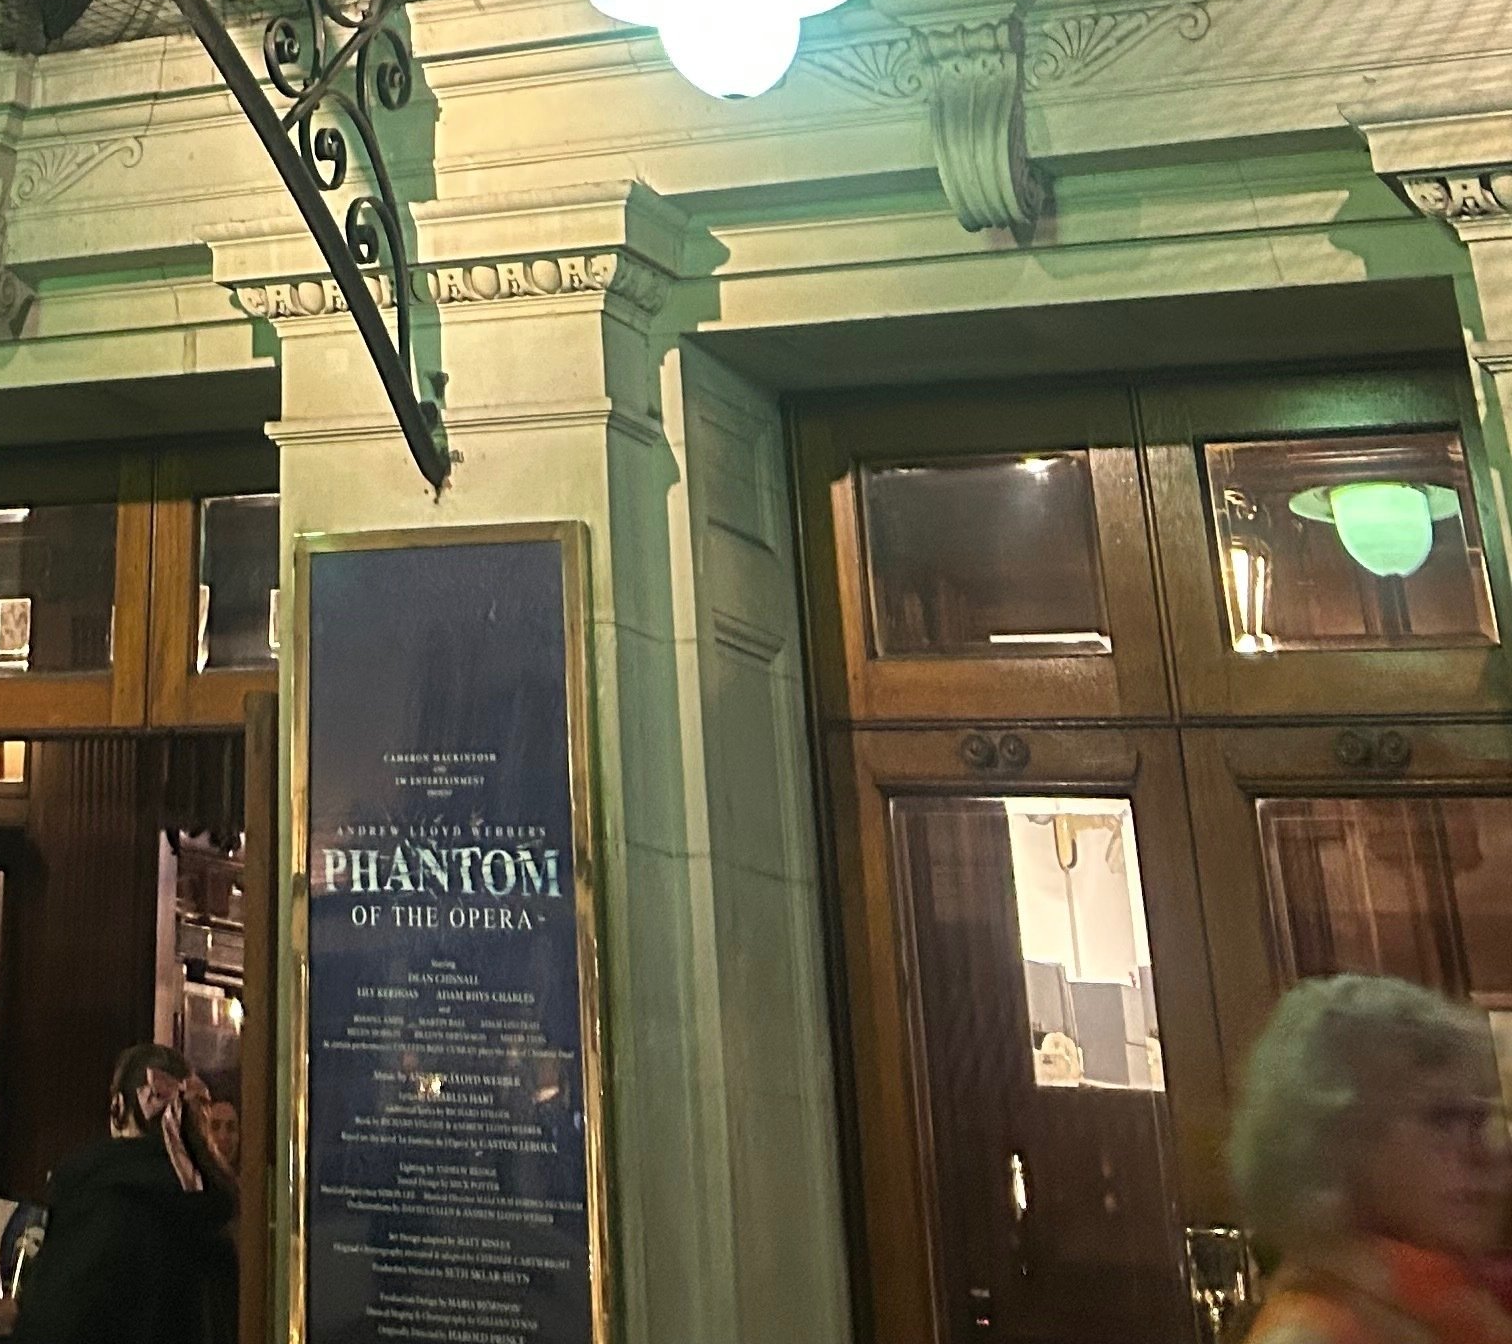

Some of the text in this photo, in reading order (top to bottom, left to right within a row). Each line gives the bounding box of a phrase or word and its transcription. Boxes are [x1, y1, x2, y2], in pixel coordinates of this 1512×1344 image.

[383, 752, 497, 763] CAMERON MACKINTOSH
[410, 776, 485, 786] ENTERTAINMENT
[336, 825, 399, 837] ANDREW
[410, 825, 462, 837] LLOYD
[322, 839, 563, 898] PHANTOM
[351, 904, 533, 930] OF THE OPERA
[407, 973, 434, 985] DEAN
[435, 989, 464, 1002] ADAM
